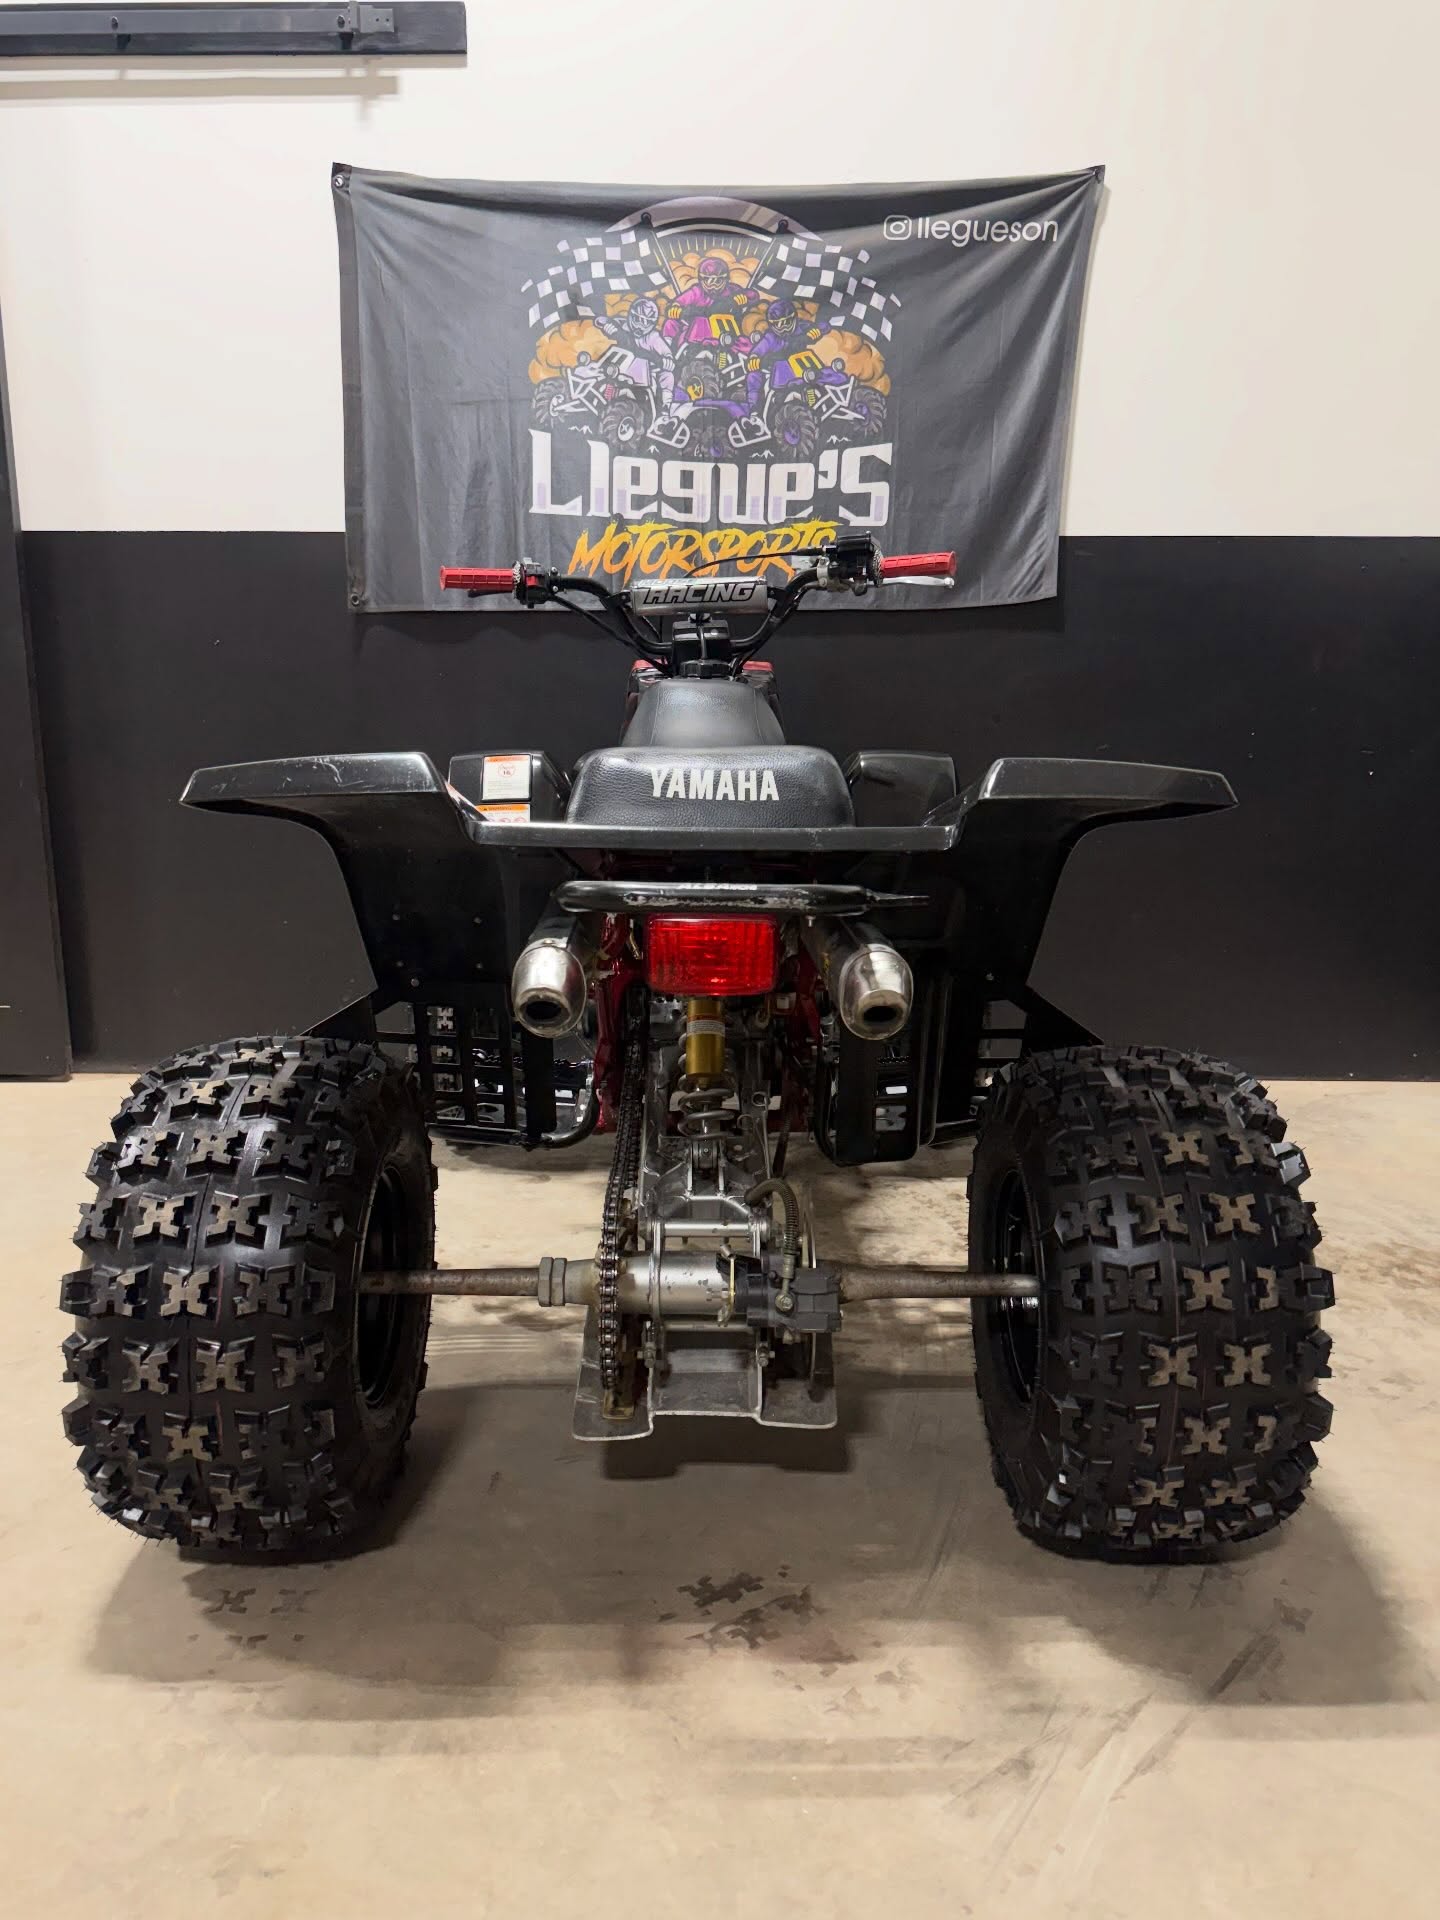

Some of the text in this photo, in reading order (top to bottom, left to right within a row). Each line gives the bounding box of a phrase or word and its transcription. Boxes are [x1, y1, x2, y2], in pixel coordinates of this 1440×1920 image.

[917, 217, 1059, 248] llegueson
[643, 583, 757, 605] RACING
[650, 768, 780, 801] YAMAHA
